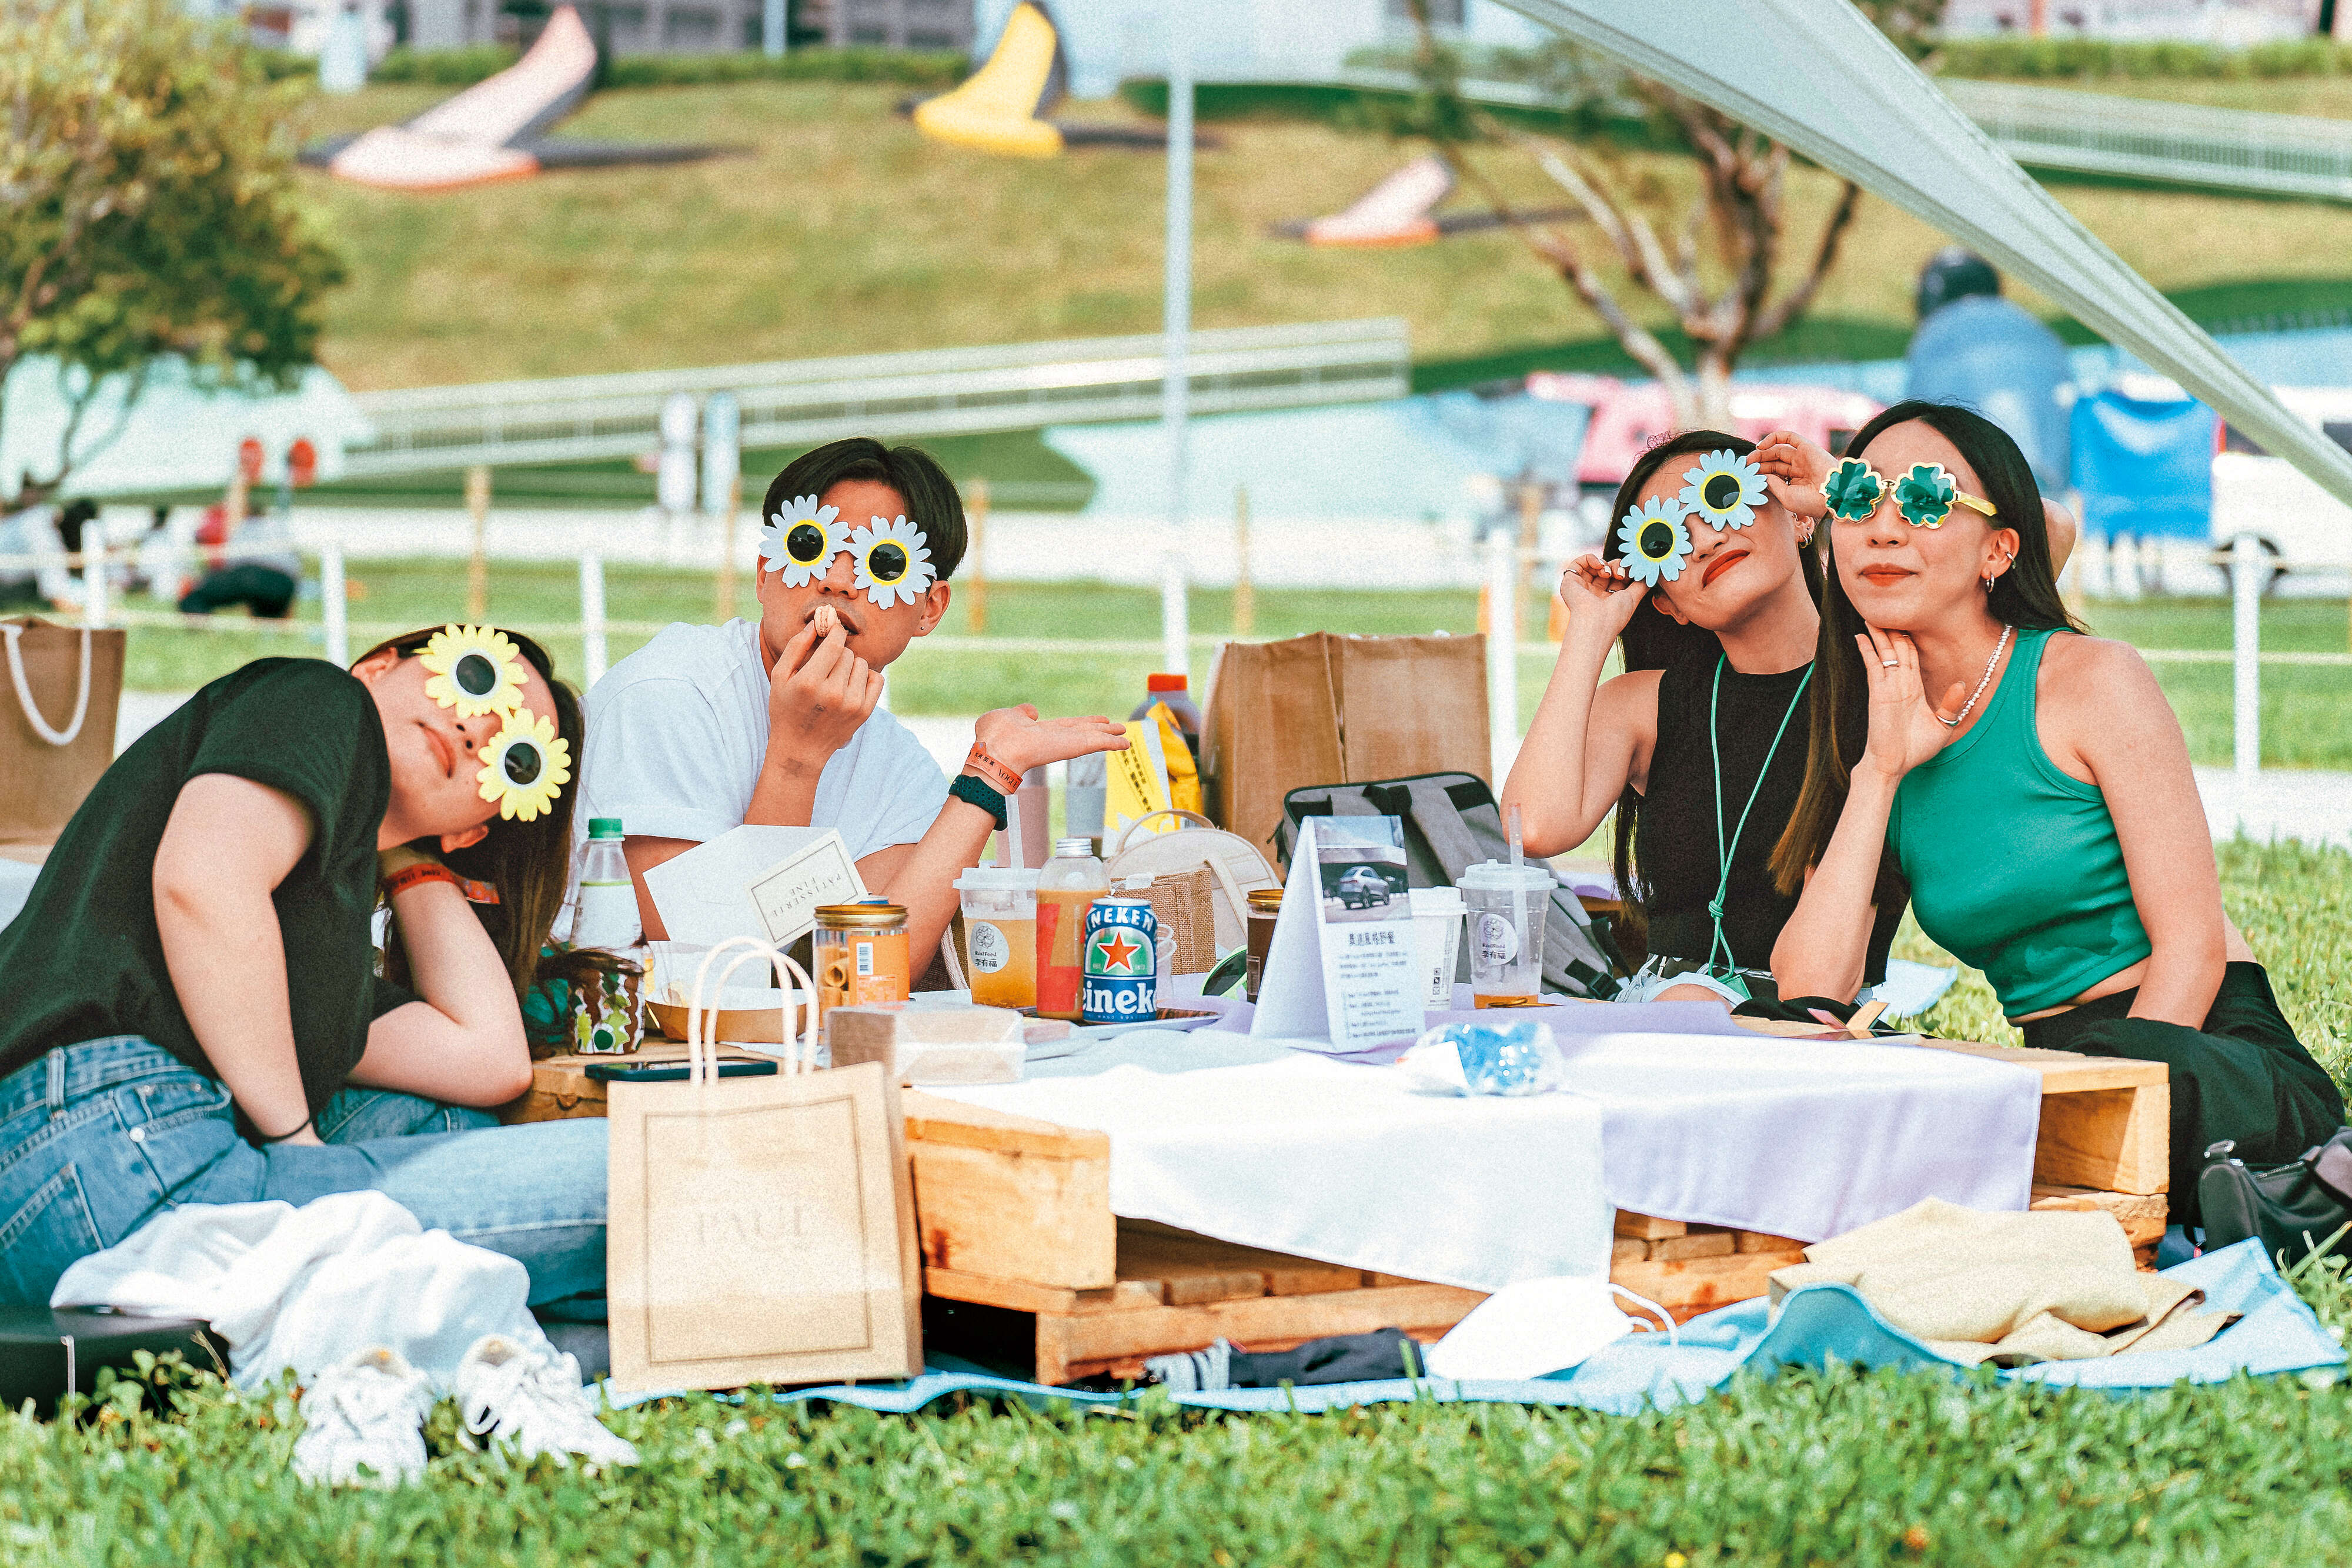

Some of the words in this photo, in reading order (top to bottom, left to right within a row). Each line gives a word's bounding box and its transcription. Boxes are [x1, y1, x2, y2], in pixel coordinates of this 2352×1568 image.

[998, 768, 1021, 789] VOGUE
[974, 958, 998, 967] 李有福
[1083, 981, 1157, 1014] inek
